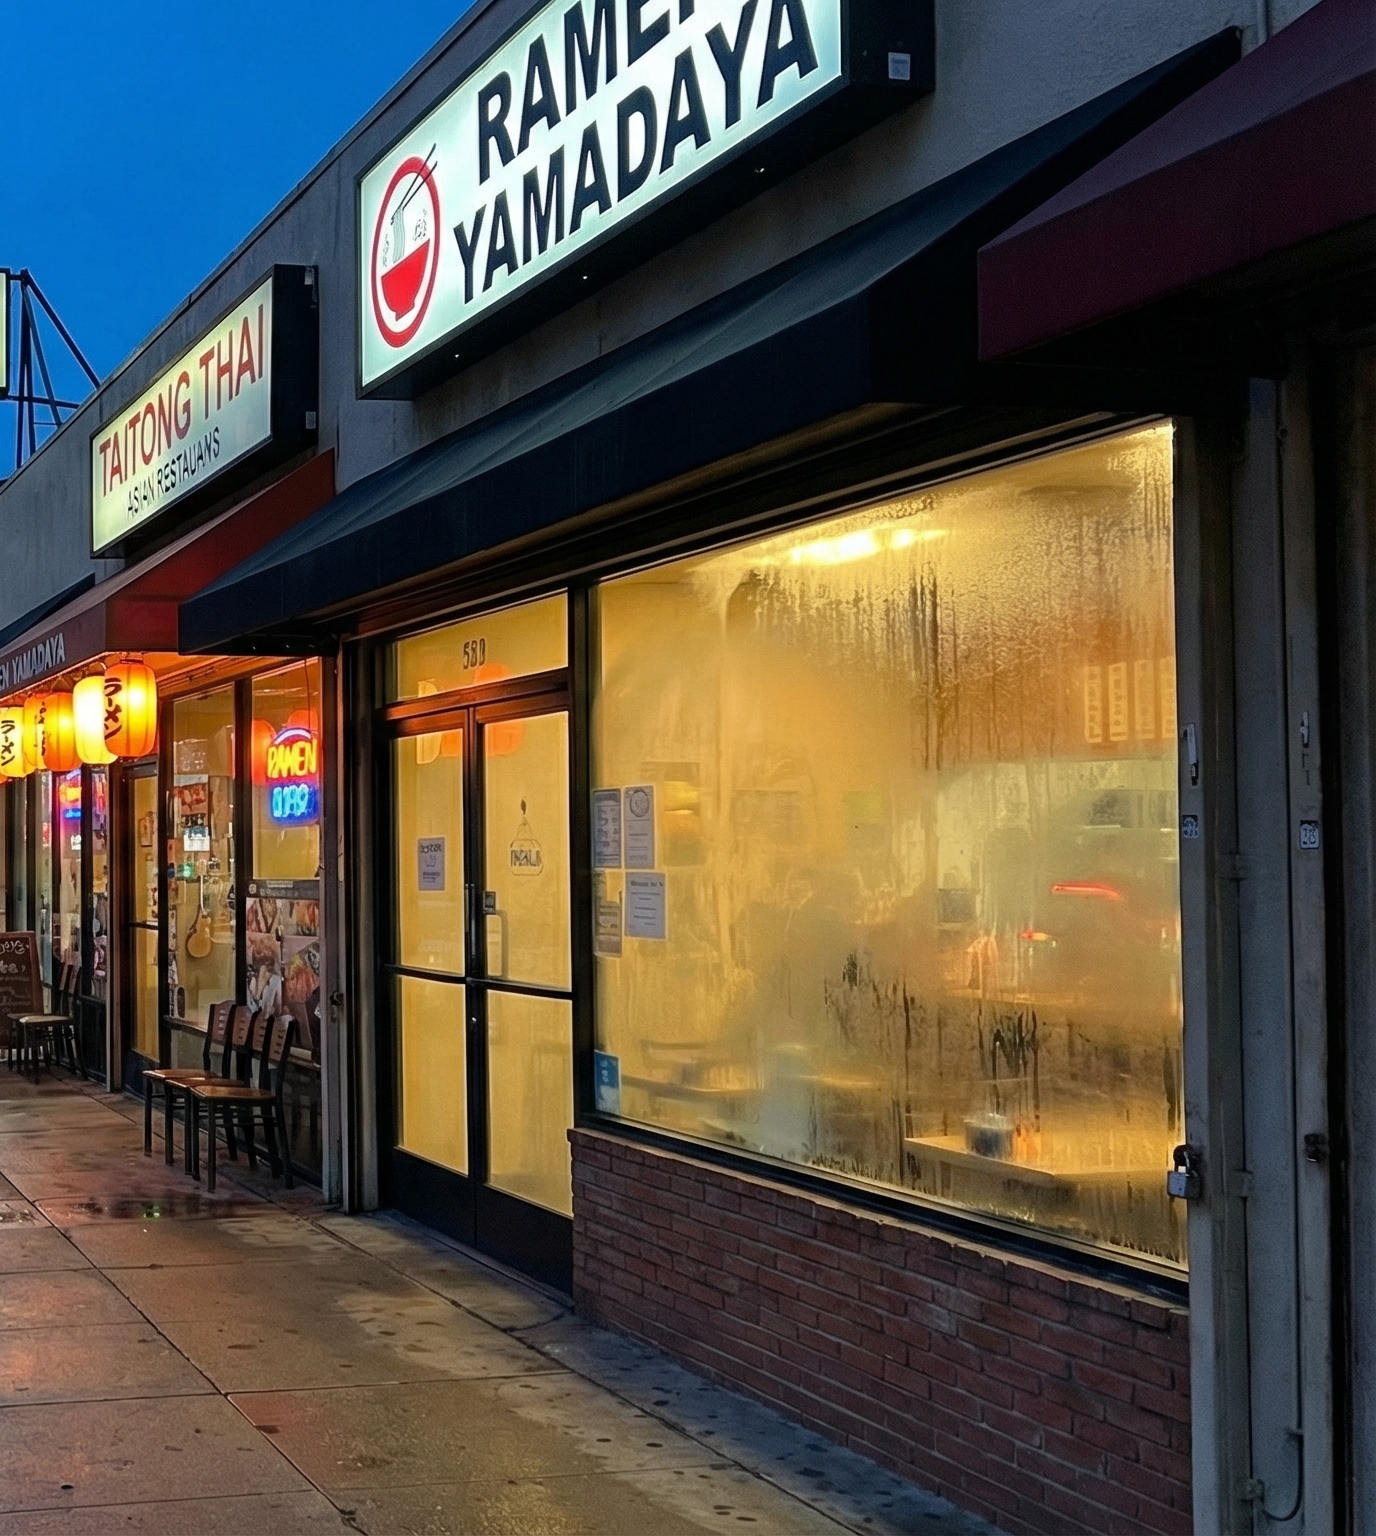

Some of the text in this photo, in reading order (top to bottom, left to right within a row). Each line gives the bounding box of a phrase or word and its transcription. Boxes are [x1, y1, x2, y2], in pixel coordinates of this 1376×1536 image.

[478, 0, 695, 186] RAME
[453, 0, 818, 304] YAMADAYA
[99, 304, 264, 497] TAITONG THAI
[127, 470, 155, 520] ASIAN
[12, 632, 65, 685] YAMADAYA
[1, 720, 15, 766] ラーメン
[267, 739, 317, 778] RAMEN
